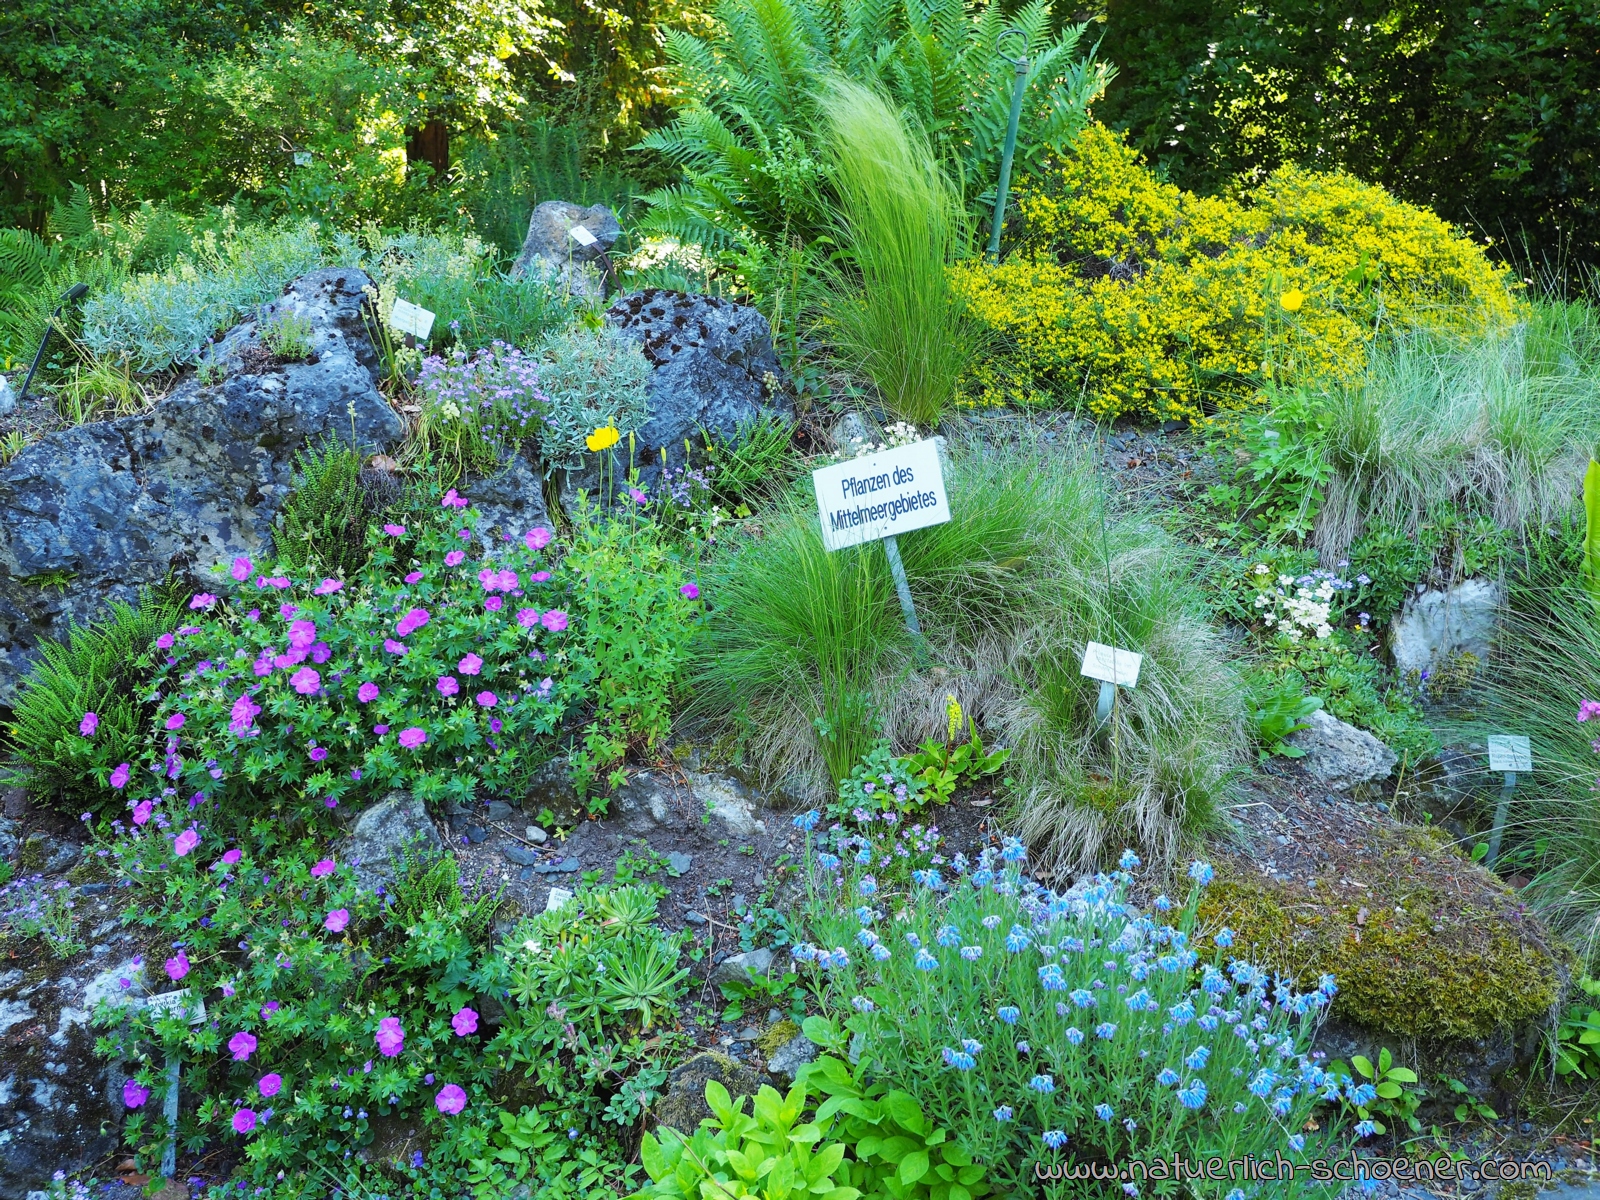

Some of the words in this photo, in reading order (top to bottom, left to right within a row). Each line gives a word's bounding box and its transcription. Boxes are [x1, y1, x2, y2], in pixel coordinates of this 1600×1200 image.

[841, 472, 891, 499] Pflanzen
[893, 465, 914, 485] des
[830, 490, 937, 532] Mittelmeergebietes
